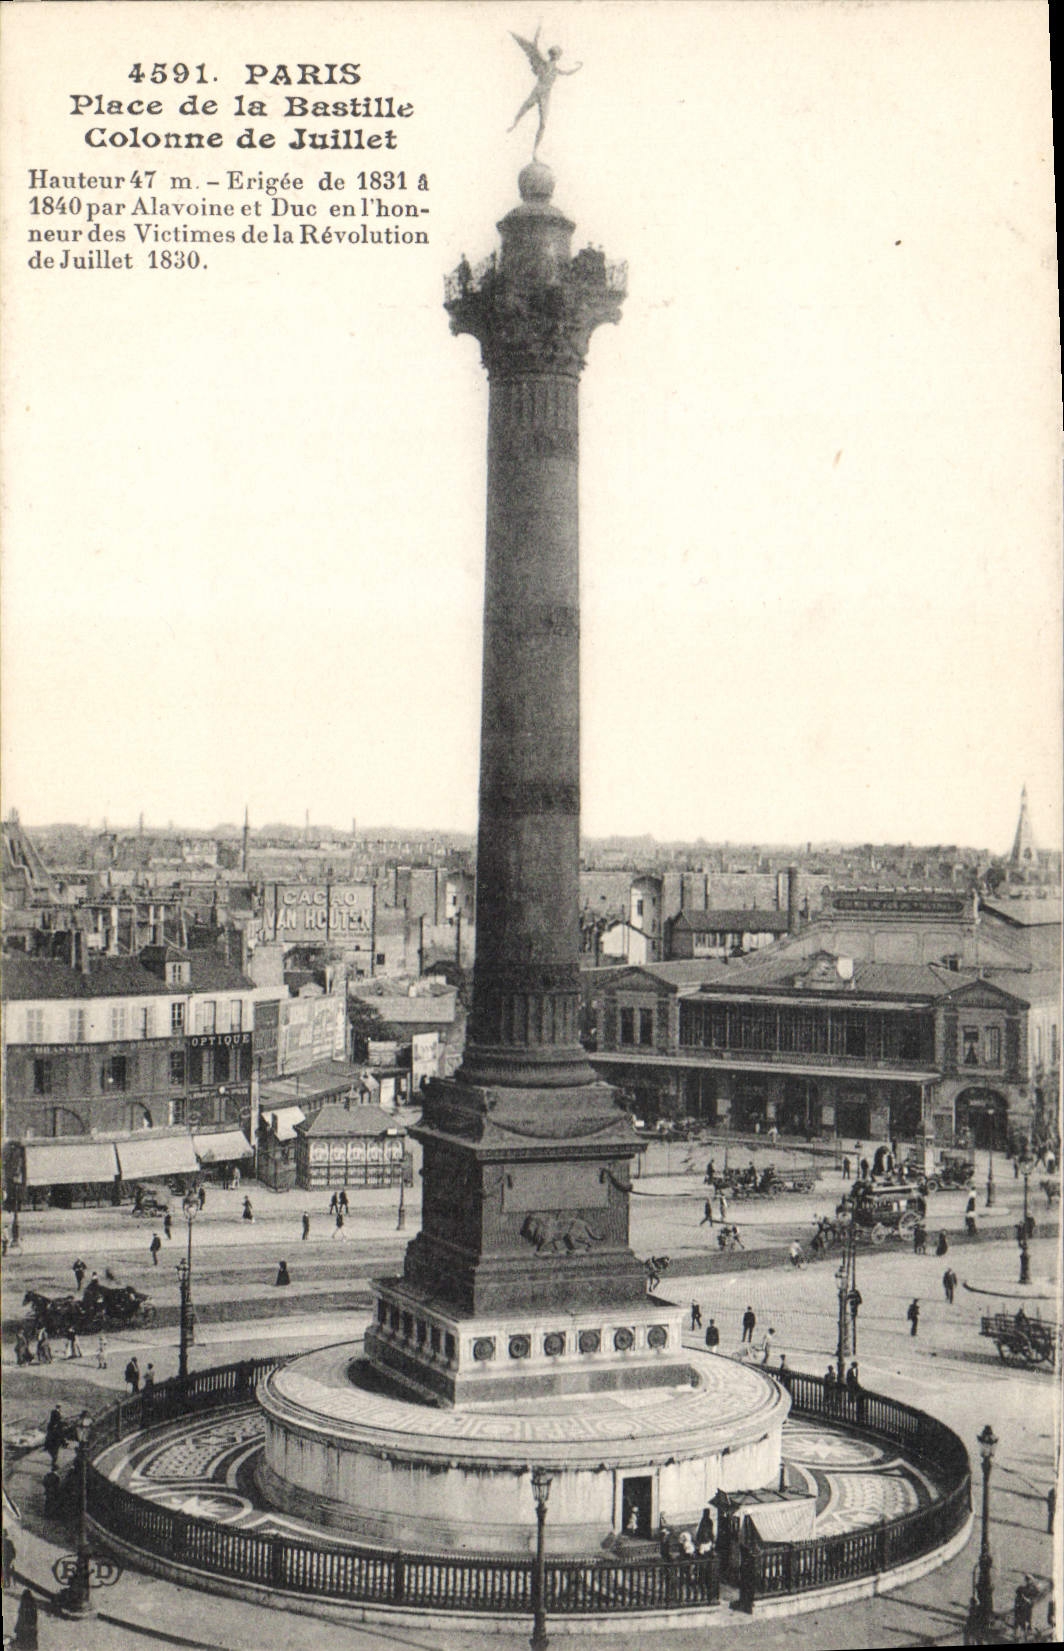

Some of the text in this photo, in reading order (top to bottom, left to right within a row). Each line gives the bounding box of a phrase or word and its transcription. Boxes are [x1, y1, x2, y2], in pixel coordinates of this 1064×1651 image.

[282, 890, 358, 906] CACAO
[265, 908, 297, 931] VAN
[191, 1033, 250, 1047] OPTIQUE
